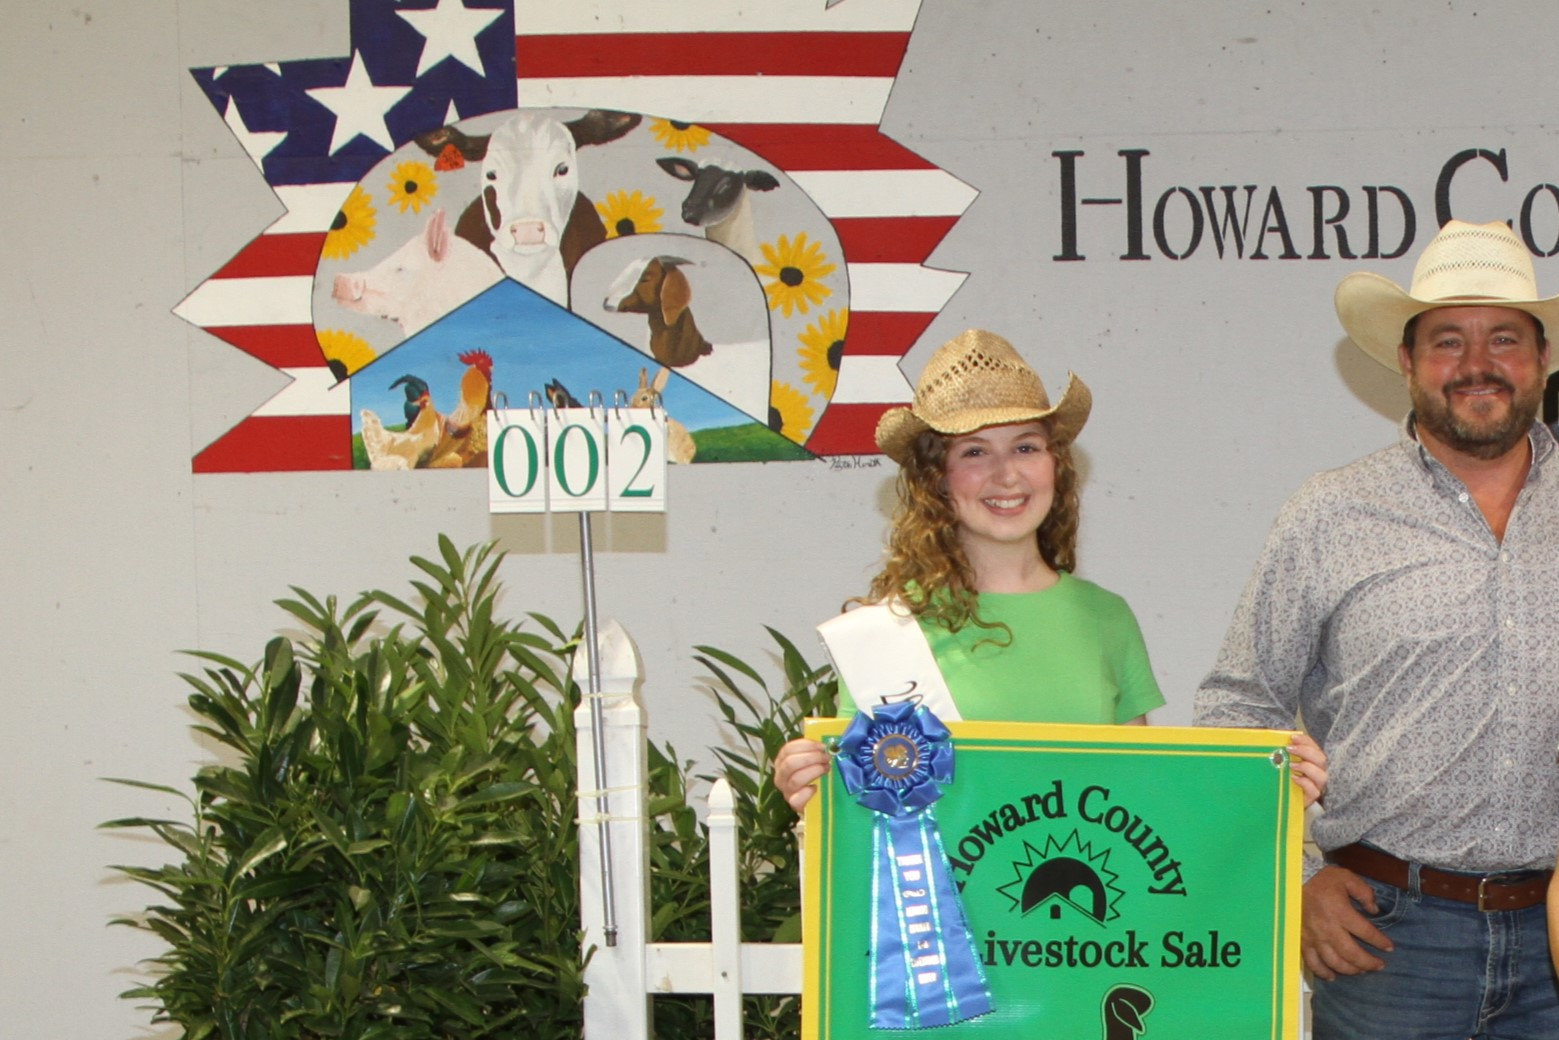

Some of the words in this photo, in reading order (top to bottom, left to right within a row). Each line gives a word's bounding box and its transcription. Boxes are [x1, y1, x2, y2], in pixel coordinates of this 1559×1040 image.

[1052, 149, 1417, 261] HOWARD
[493, 424, 655, 497] 002
[1077, 785, 1188, 897] County
[981, 930, 1149, 967] ivestock
[1160, 930, 1241, 968] Sale
